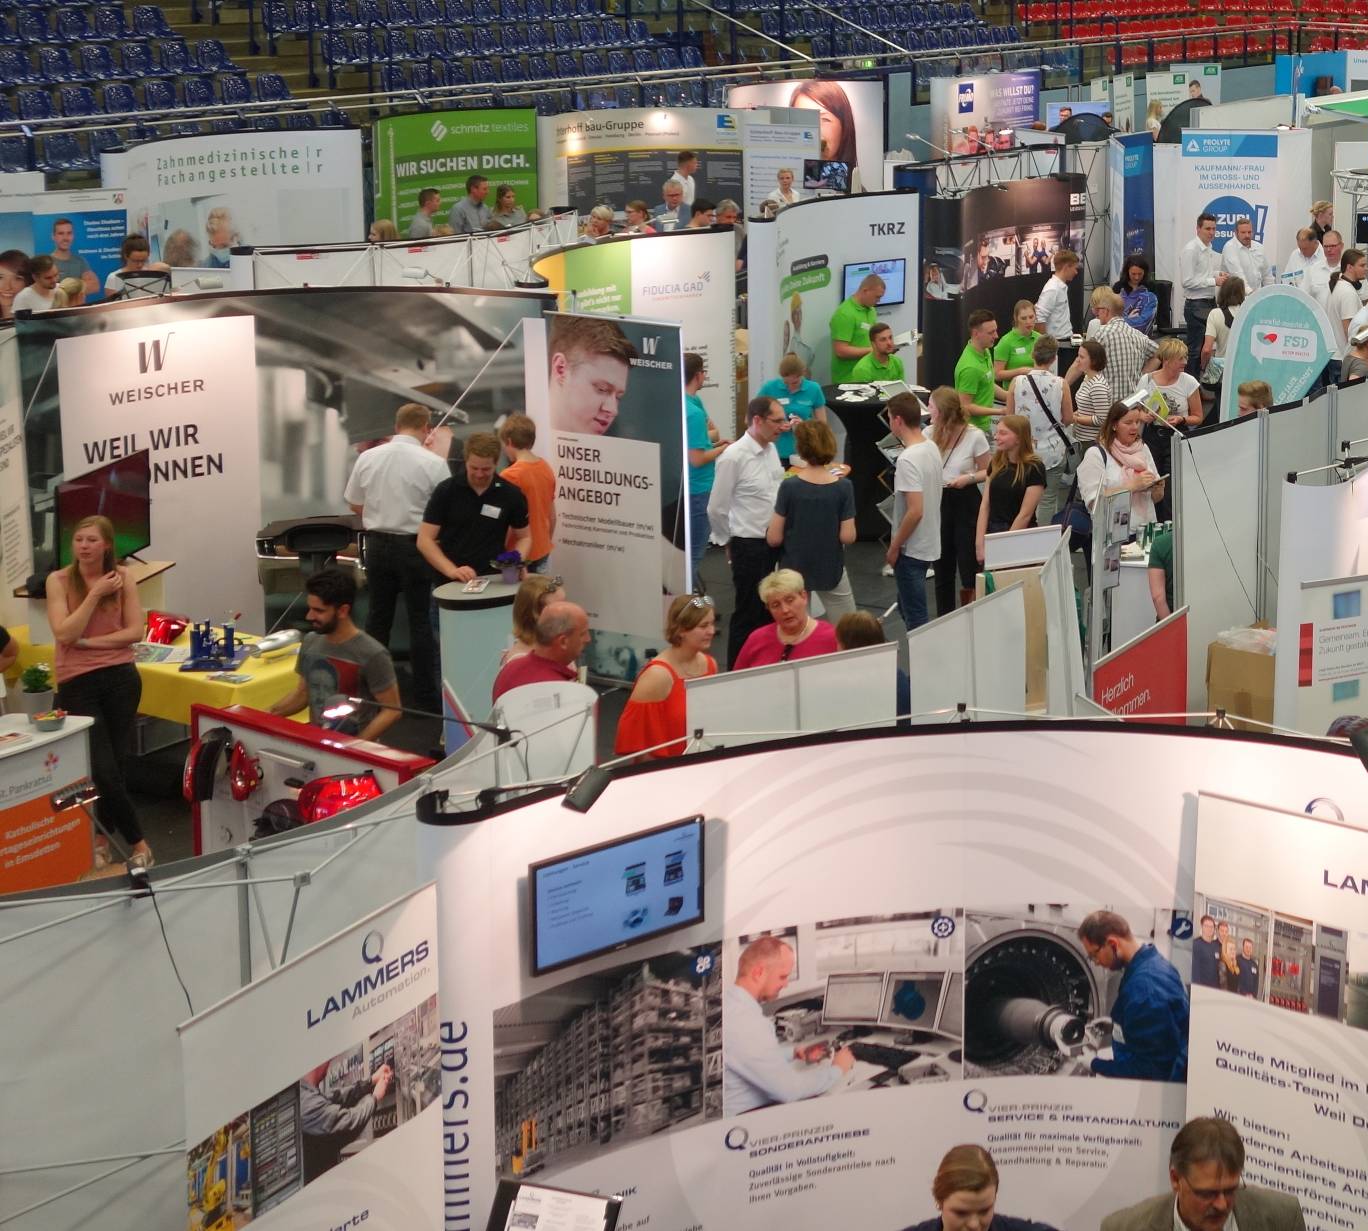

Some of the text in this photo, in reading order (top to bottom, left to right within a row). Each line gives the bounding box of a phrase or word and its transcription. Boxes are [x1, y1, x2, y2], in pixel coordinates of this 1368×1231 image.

[1003, 86, 1023, 97] WILLST
[450, 122, 529, 135] schmitz textiles
[1202, 138, 1231, 147] PROLYTE
[396, 153, 530, 177] WIR SUCHEN DICH.
[1194, 164, 1265, 173] KAUFMANN/-FRAU
[1198, 182, 1261, 190] AUSSENHANDEL
[1199, 173, 1208, 181] IM
[869, 221, 906, 237] TKRZ
[642, 281, 705, 297] FIDUCIA GAD
[138, 331, 176, 374] W
[642, 335, 662, 355] W
[1283, 335, 1309, 349] FSD
[629, 356, 673, 370] WEISCHER
[108, 378, 205, 406] WEISCHER
[82, 423, 200, 465] WEIL WIR
[557, 444, 601, 463] UNSER
[149, 452, 224, 484] NNEN
[557, 465, 654, 490] AUSBILDUNGS-
[558, 485, 622, 507] ANGEBOT
[1101, 671, 1134, 708] Herzlich
[306, 939, 430, 1030] LAMMERS
[351, 966, 431, 1021] Automation.
[1215, 1039, 1265, 1066] Werde
[1269, 1056, 1336, 1086] Mitglied
[1340, 1075, 1360, 1092] im
[1215, 1057, 1341, 1104] Qualitäts-Team!
[987, 1112, 1181, 1130] SERVICE & INSTANDHALTUNG
[1313, 1102, 1347, 1123] Weil
[1213, 1106, 1291, 1142] Wir bieten:
[749, 1127, 871, 1159] SONDERANTRIEBE
[987, 1132, 1143, 1148] Qualität für maximale Verfügbarkeit:
[1240, 1135, 1286, 1157] oderne
[993, 1156, 1052, 1167] standhaltung
[1065, 1158, 1109, 1169] Reparatur.
[1056, 1146, 1074, 1154] von
[1075, 1146, 1110, 1158] Service,
[748, 1149, 856, 1179] Qualität in Vollstufigkeit:
[748, 1156, 896, 1192] Zuverlässige Sonderantriebe nach
[1245, 1154, 1338, 1189] morientierte
[748, 1181, 817, 1204] Ihren Vorgaben.
[1300, 1205, 1355, 1230] archien
